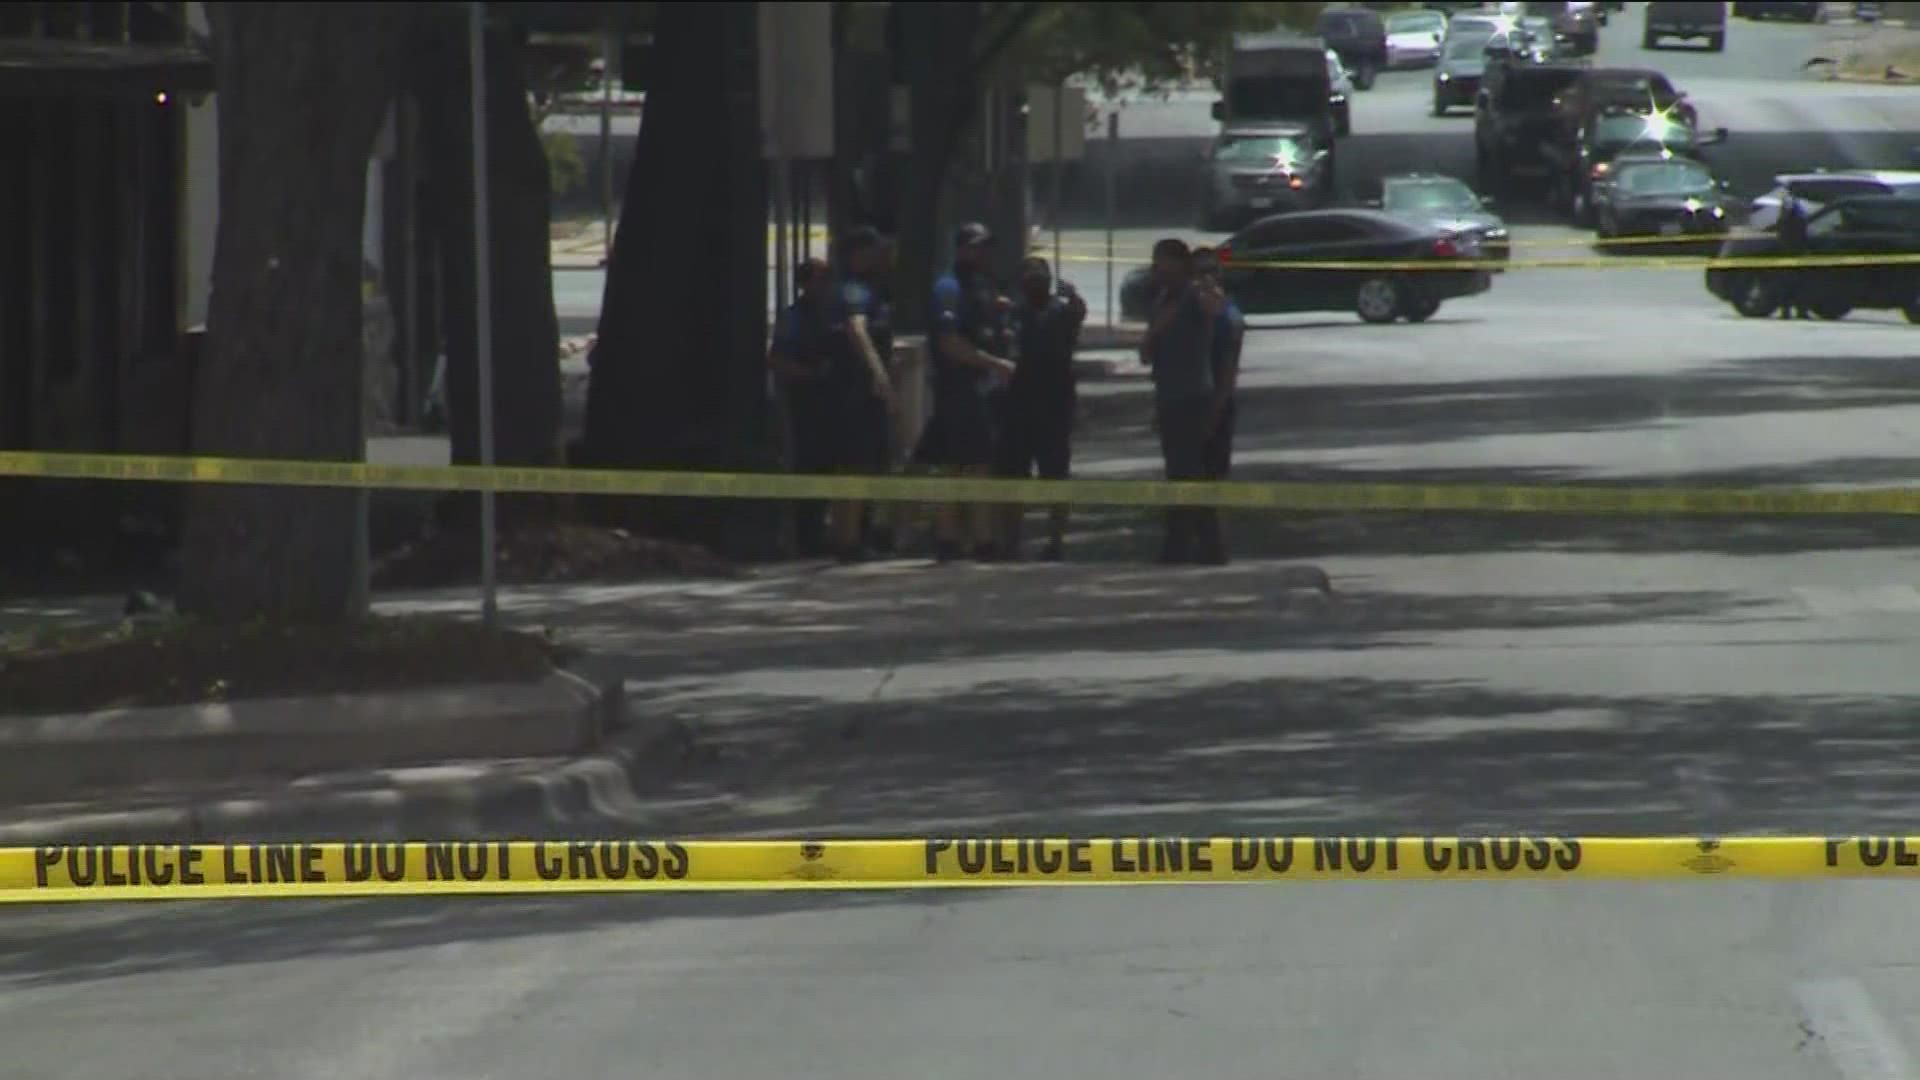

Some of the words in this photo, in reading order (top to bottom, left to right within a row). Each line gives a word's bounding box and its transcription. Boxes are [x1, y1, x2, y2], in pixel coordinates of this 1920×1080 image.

[35, 844, 204, 887] POLICE
[223, 844, 326, 884] LINE
[343, 842, 406, 882] DO
[425, 841, 511, 881] NOT
[535, 840, 689, 880] CROSS
[925, 838, 1092, 874] POLICE
[1112, 838, 1213, 872] LINE
[1231, 837, 1294, 872] DO
[1314, 837, 1398, 872] NOT
[1423, 836, 1582, 871] CROSS
